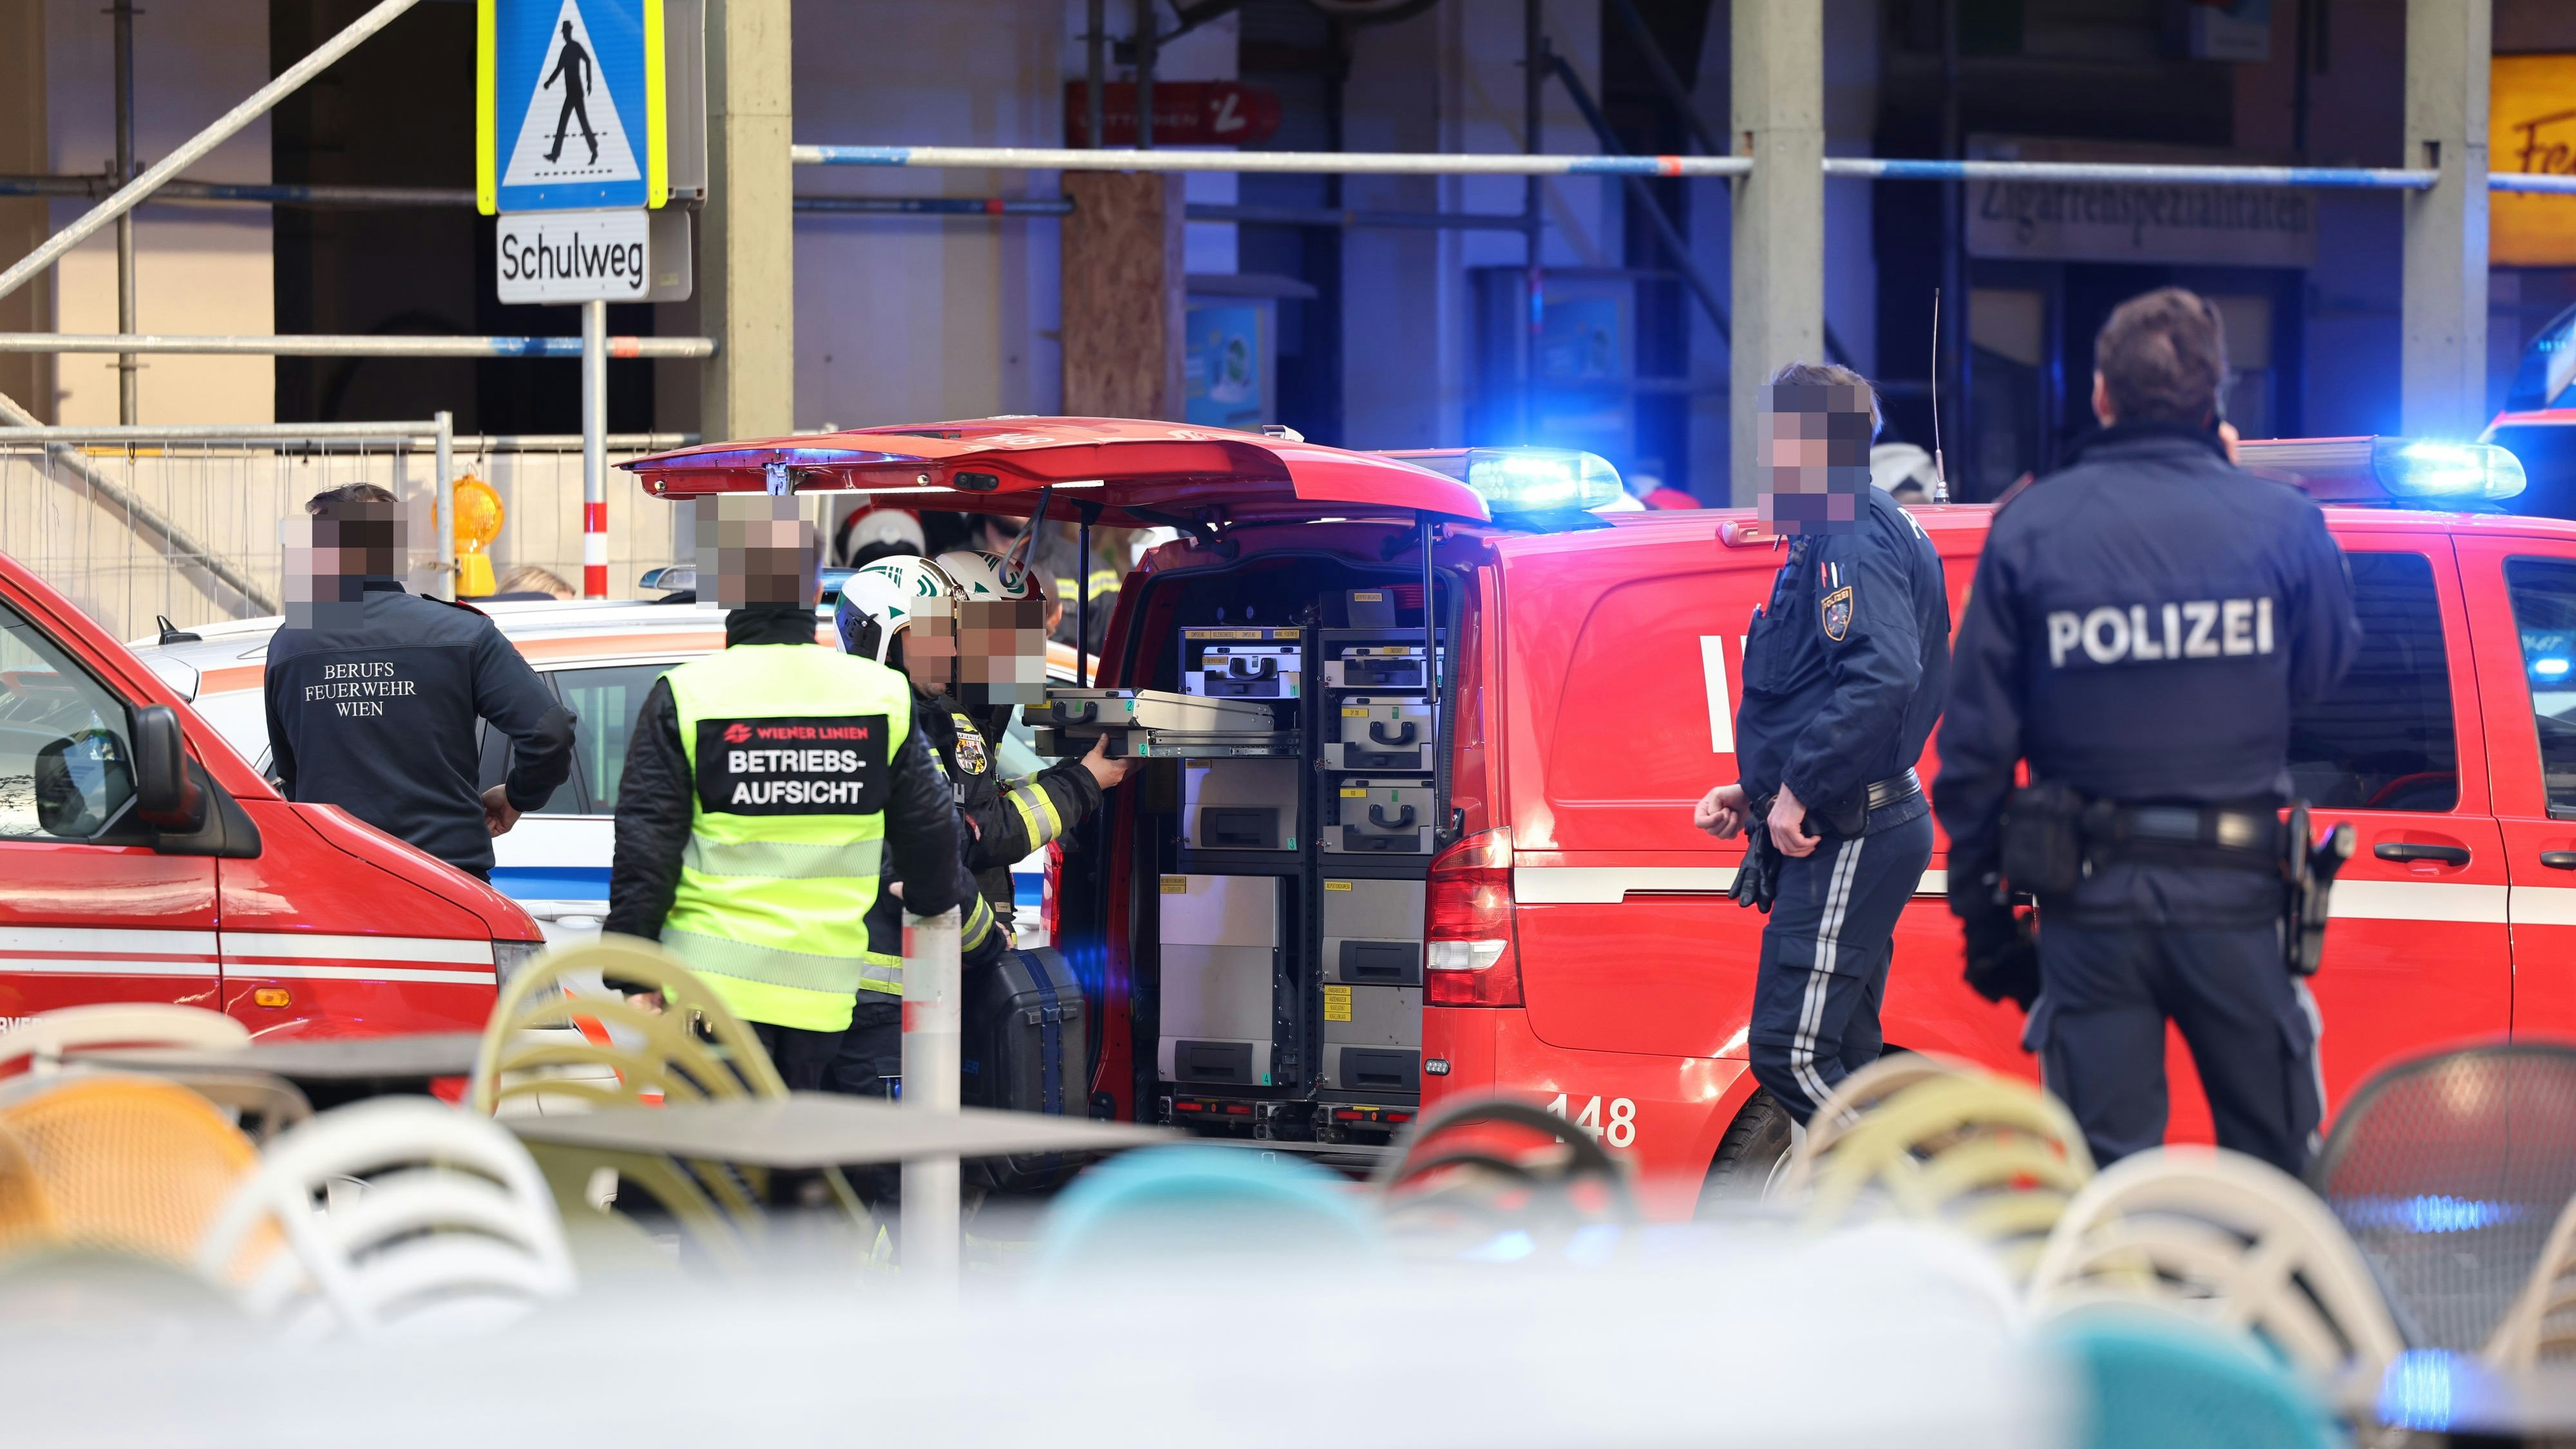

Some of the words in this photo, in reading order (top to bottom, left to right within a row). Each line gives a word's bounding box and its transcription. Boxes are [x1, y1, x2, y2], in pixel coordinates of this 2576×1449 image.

[502, 231, 643, 290] Schulweg
[1823, 589, 1849, 610] POLIZEI
[2047, 596, 2275, 668] POLIZEI
[324, 662, 394, 679] BERUFS
[305, 681, 417, 701] FEUERWEHR
[336, 701, 384, 717] WIEN
[1127, 701, 1132, 711] 2
[756, 726, 817, 740] WIENER
[819, 726, 869, 740] LINIEN
[1141, 744, 1146, 755] 2
[728, 750, 866, 773] BETRIEBS-
[731, 781, 864, 805] AUFSICHT
[1289, 838, 1294, 849] 3
[1264, 1074, 1269, 1084] 4
[1546, 1093, 1636, 1148] 148
